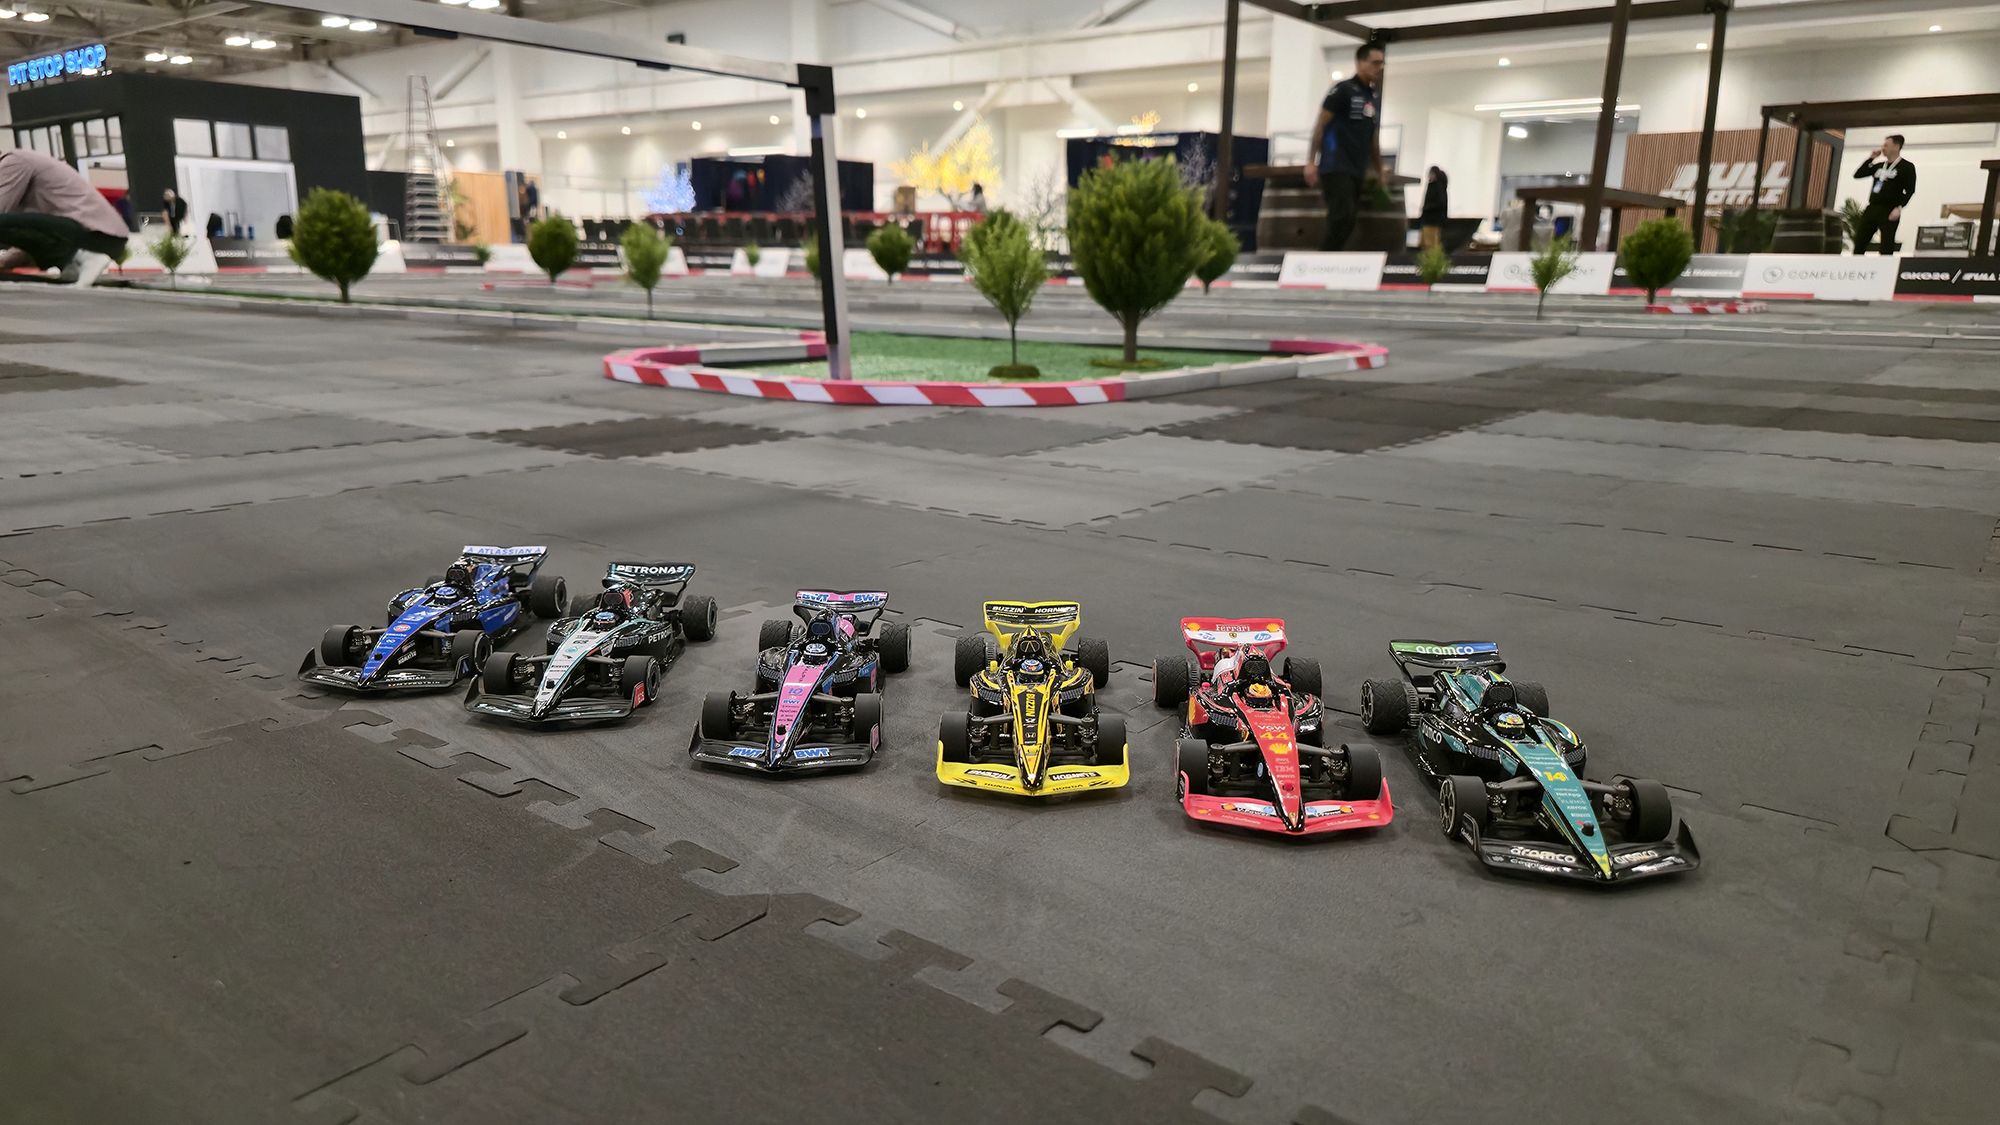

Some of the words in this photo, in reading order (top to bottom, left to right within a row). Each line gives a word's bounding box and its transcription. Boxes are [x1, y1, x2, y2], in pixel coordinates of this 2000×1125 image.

[8, 62, 28, 85] PIT
[28, 54, 64, 81] STOP
[65, 44, 106, 73] SHOP
[1788, 270, 1876, 281] CONFLUENT
[616, 564, 685, 575] PETRONAS
[1215, 624, 1251, 632] Ferrari
[1416, 646, 1474, 655] aramco
[732, 748, 763, 757] BWT
[795, 748, 829, 758] BWT
[1544, 771, 1567, 782] 14
[1510, 846, 1576, 863] aramco
